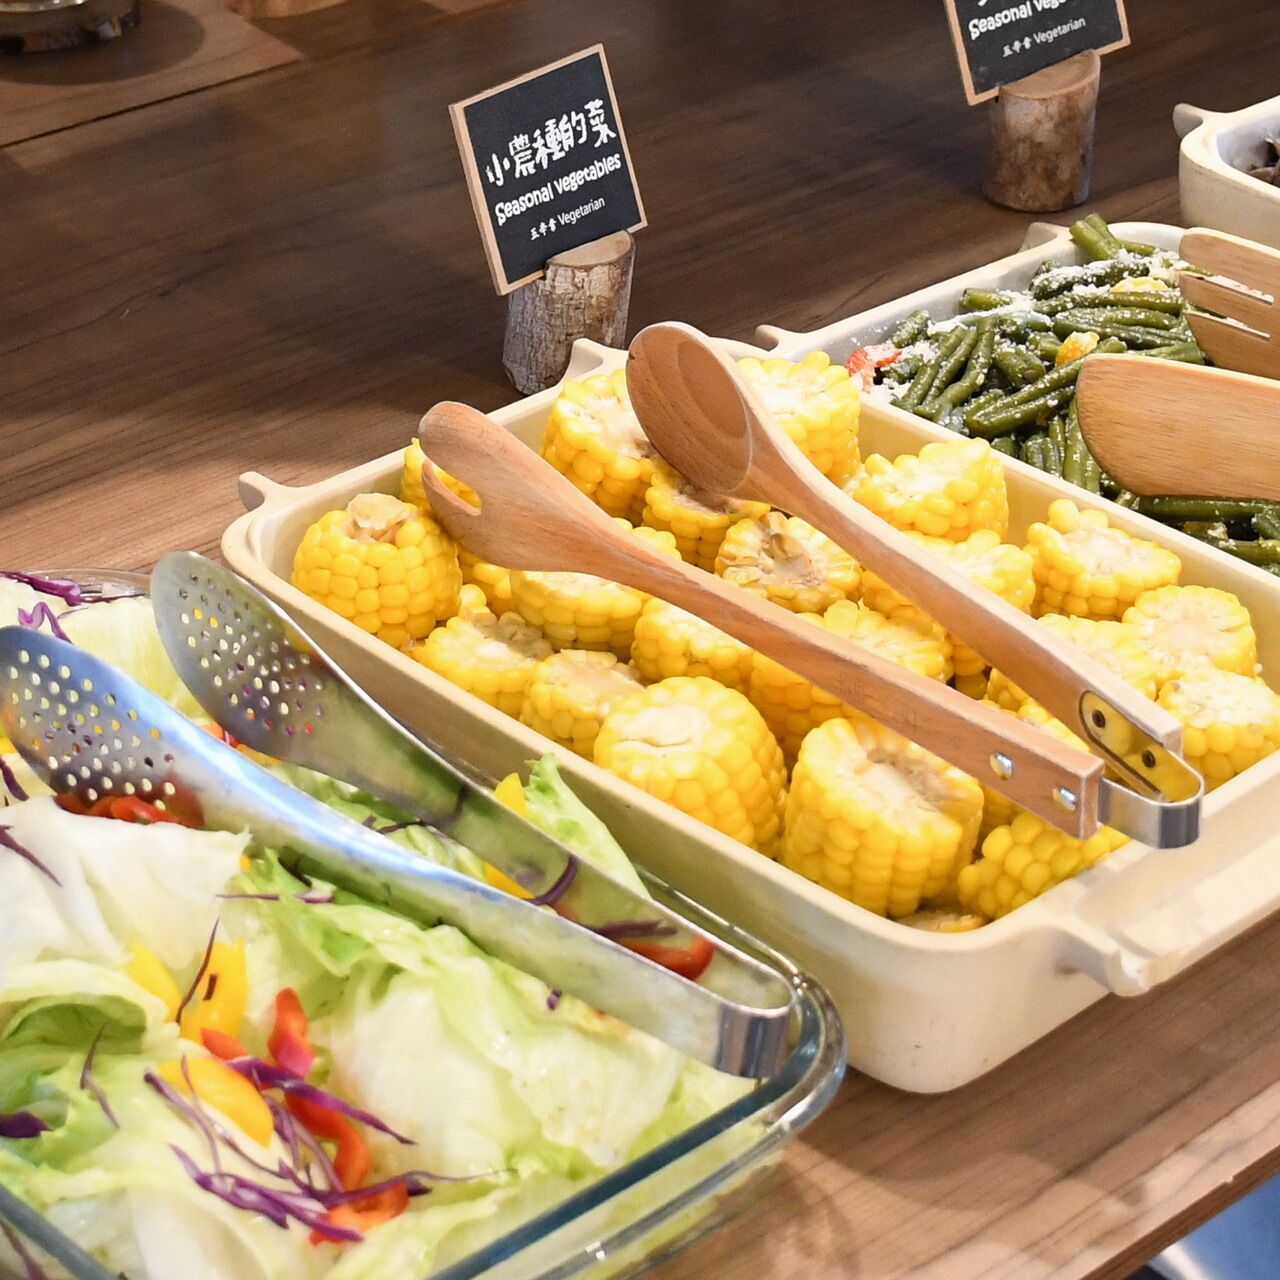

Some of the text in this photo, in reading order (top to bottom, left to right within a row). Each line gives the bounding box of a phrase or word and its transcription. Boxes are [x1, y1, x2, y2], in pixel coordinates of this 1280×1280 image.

[968, 0, 1032, 40] Seasonal
[1033, 17, 1086, 44] Vegetarian
[485, 98, 617, 187] 小農種的菜
[495, 153, 622, 226] Seasonal vegetables
[557, 197, 605, 226] Vegetarian
